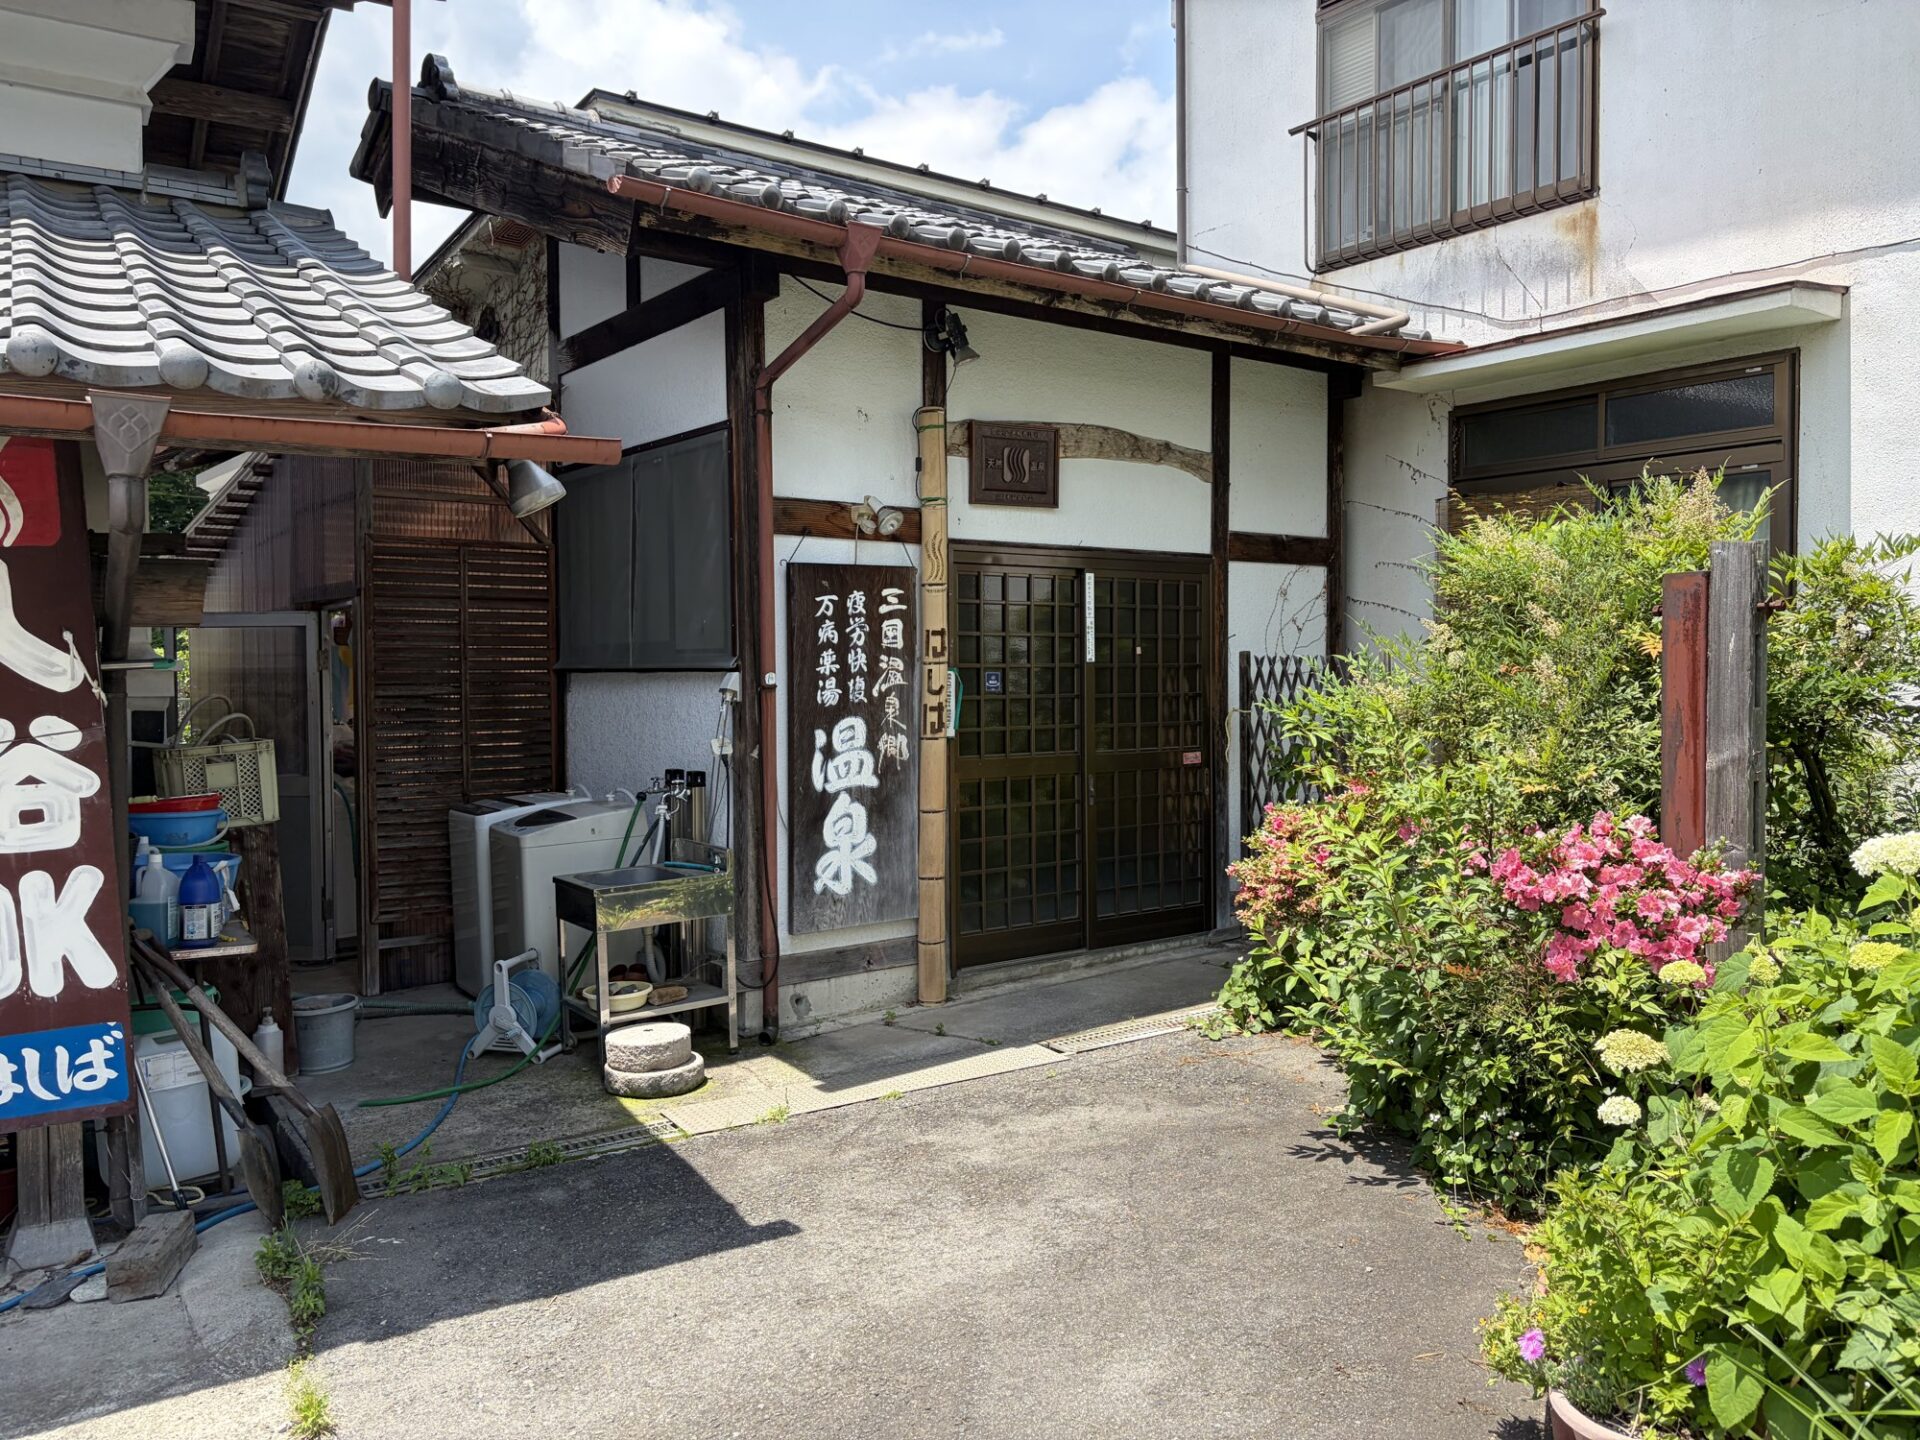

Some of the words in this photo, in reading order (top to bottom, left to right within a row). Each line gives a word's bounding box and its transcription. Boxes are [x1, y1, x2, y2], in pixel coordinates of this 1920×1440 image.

[815, 594, 842, 708] 万病薬湯
[811, 715, 880, 895] 温泉
